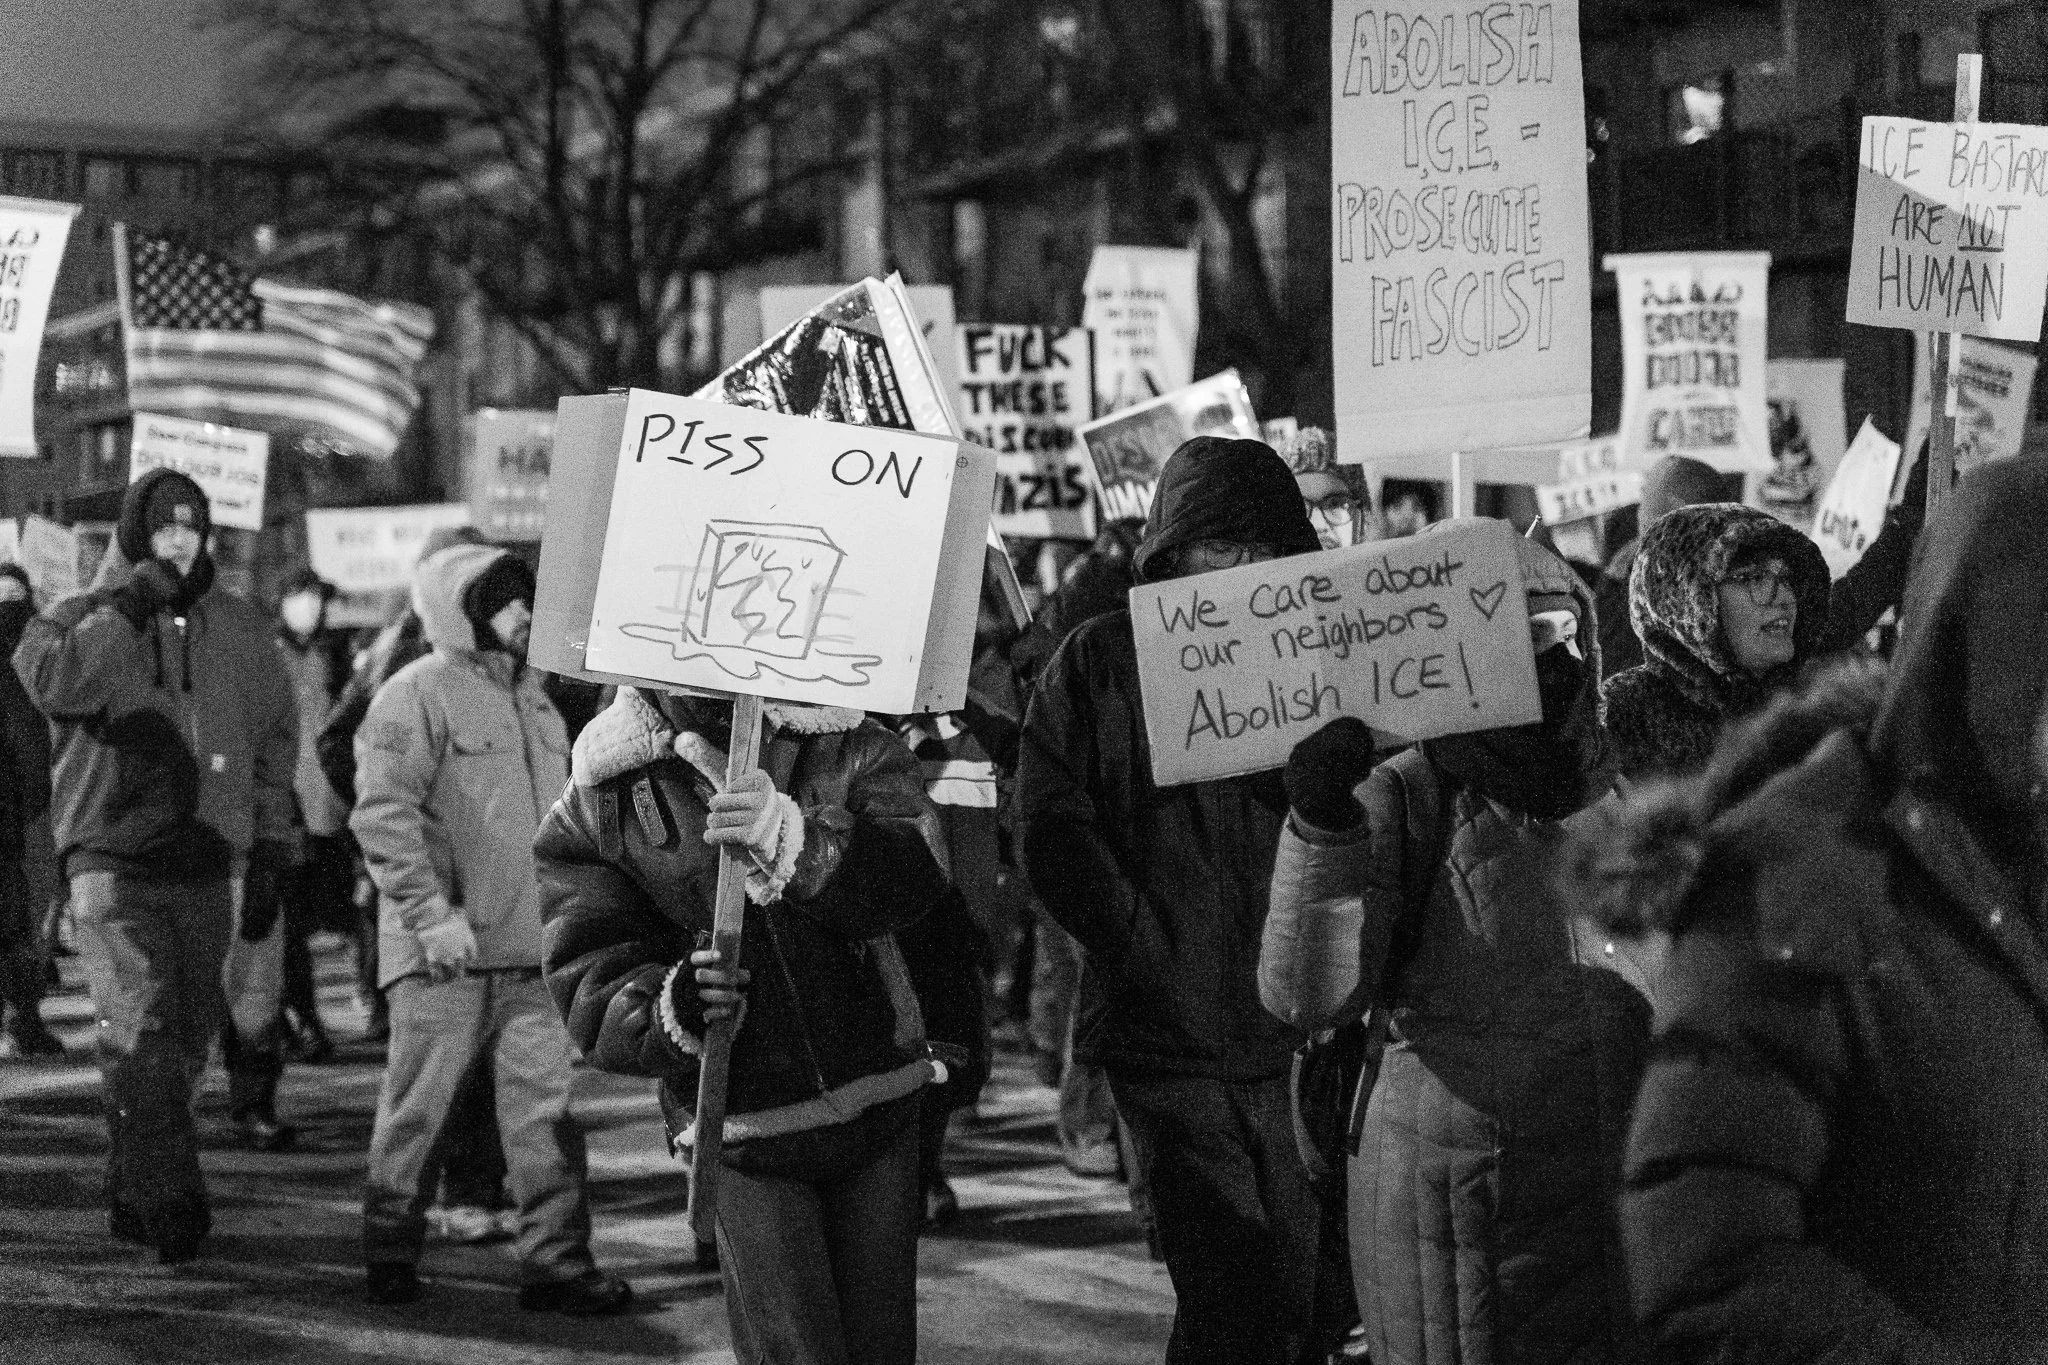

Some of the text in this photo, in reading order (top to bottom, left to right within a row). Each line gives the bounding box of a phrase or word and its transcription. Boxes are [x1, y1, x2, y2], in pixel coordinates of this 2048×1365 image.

[1343, 2, 1554, 98] ABOLISH
[1870, 124, 1926, 181] ICE
[1337, 182, 1543, 263] PROSECUTE
[1892, 193, 2022, 252] ARE NOT
[1371, 259, 1565, 367] FASCIST
[1878, 246, 2005, 323] HUMAN
[965, 327, 1072, 374] FUCK
[962, 380, 1070, 416] THESE
[636, 413, 923, 499] PISS ON
[1158, 589, 1229, 634] We
[1366, 551, 1463, 596] about
[1181, 601, 1449, 672] our neighbors
[1185, 642, 1480, 751] Abolish ICE!
